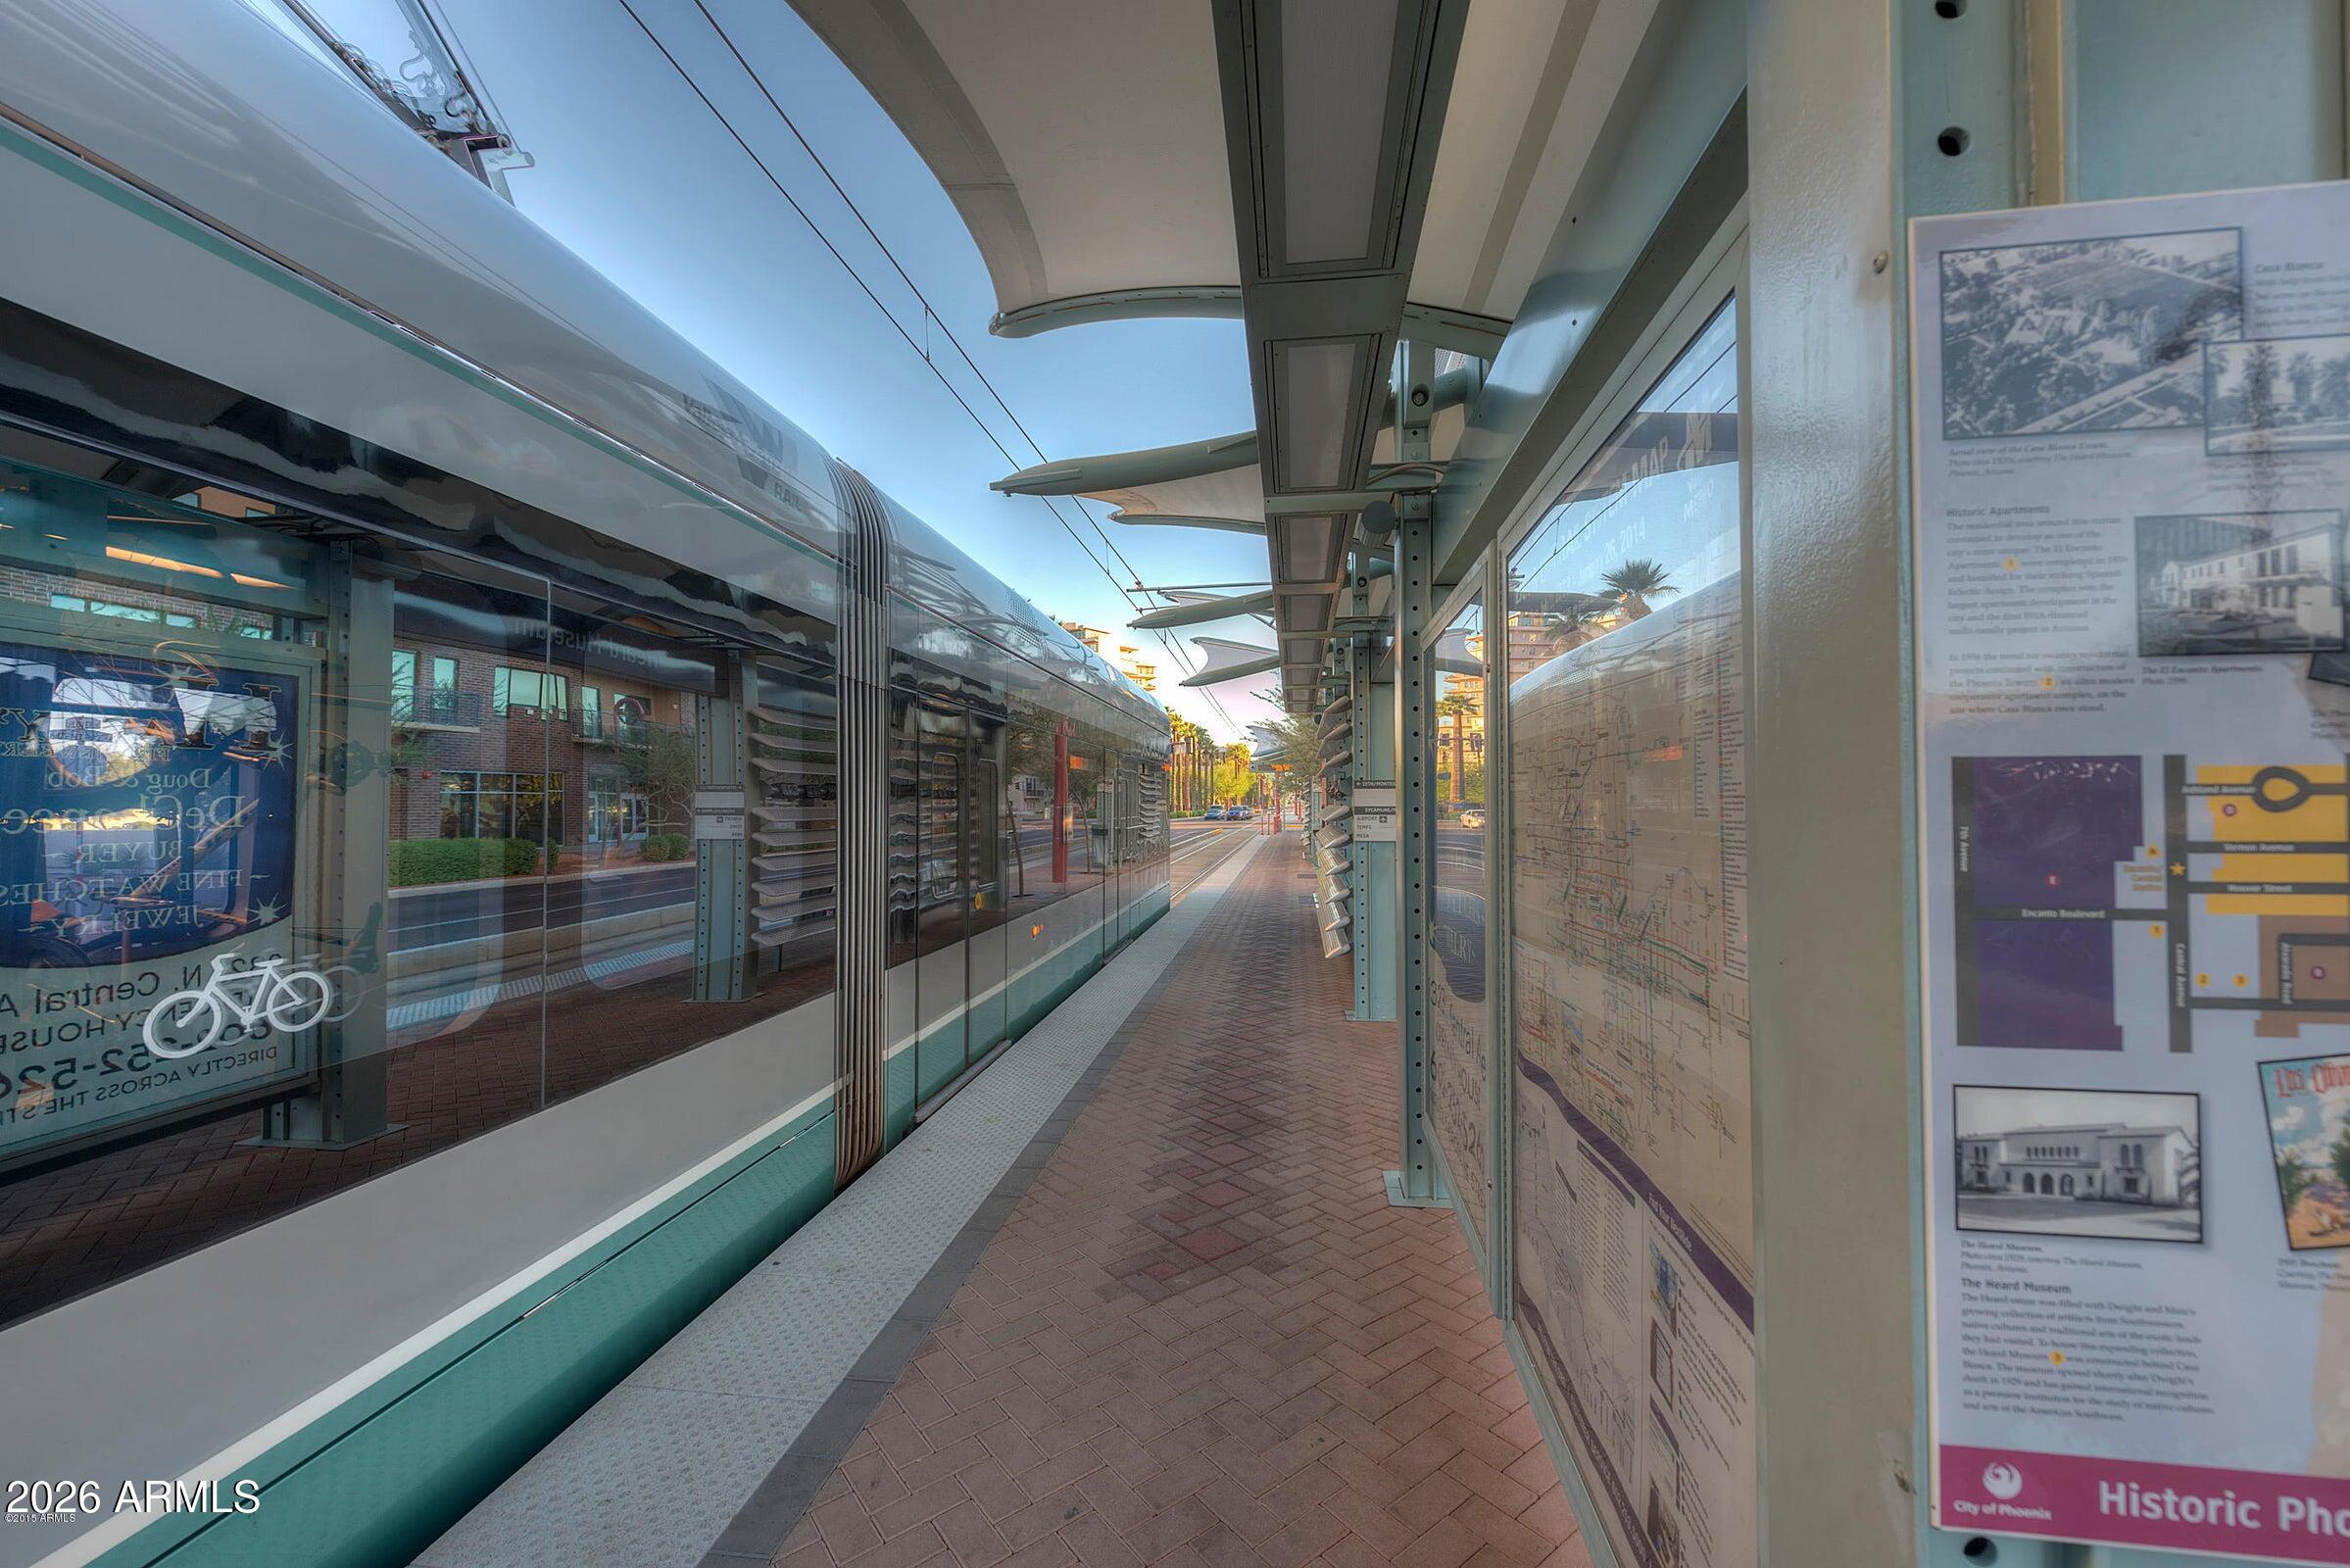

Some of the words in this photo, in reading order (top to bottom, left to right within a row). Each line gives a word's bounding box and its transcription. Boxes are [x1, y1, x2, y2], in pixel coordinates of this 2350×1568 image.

[1961, 1278, 1983, 1289] The
[1984, 1279, 2021, 1292] Heard
[2023, 1281, 2073, 1295] Museum
[1953, 1498, 1981, 1515] City
[1983, 1501, 1996, 1515] of
[1997, 1502, 2052, 1521] Phoenix
[2097, 1479, 2263, 1530] Historic
